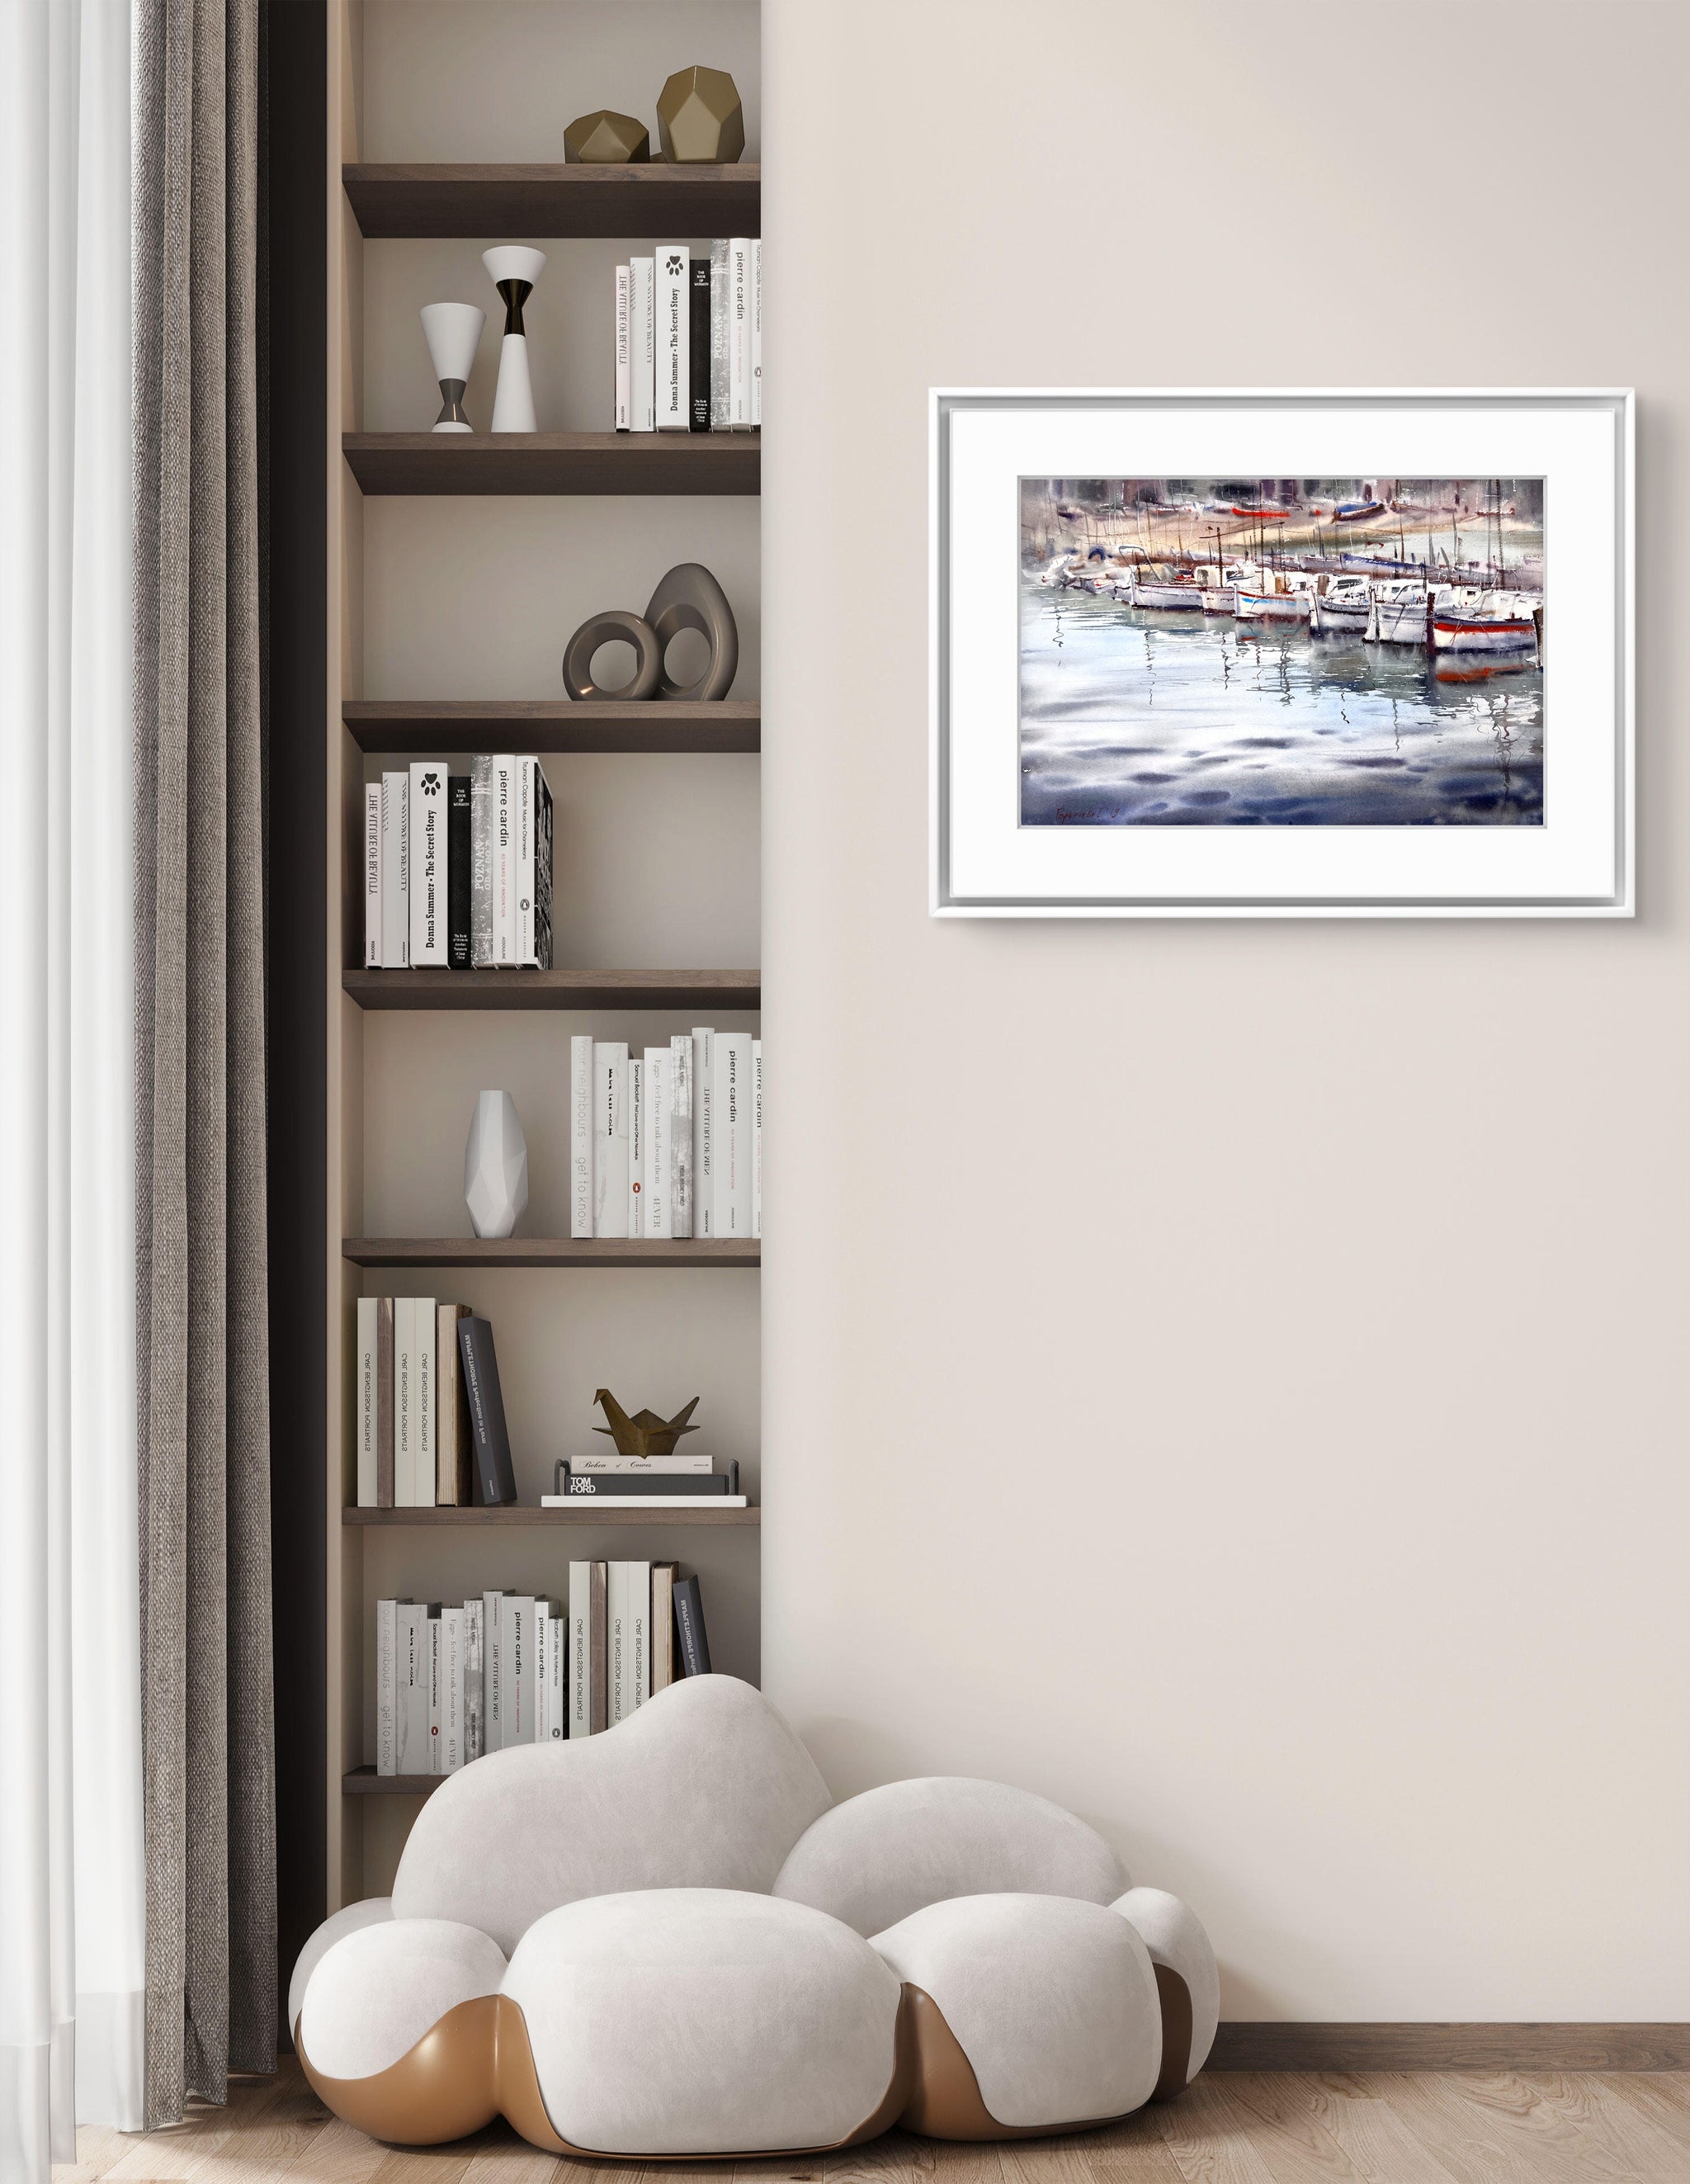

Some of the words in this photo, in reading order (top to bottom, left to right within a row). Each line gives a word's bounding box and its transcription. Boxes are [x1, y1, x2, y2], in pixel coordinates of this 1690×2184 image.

[736, 252, 744, 282] pierre
[670, 288, 680, 307] Story
[737, 286, 745, 319] cardin
[670, 310, 678, 332] Secret
[670, 333, 678, 347] The
[670, 353, 678, 385] Summer
[670, 386, 678, 411] Donna
[498, 771, 508, 805] pierre
[426, 811, 437, 831] Story
[500, 810, 509, 846] cardin
[426, 834, 435, 858] Secret
[426, 860, 435, 876] The
[426, 883, 435, 918] Summer
[426, 920, 435, 948] Donna
[729, 1051, 737, 1083] pierre
[575, 1071, 588, 1137] neighbours
[576, 1157, 588, 1175] get
[578, 1182, 588, 1192] to
[578, 1197, 588, 1228] know
[570, 1477, 591, 1486] TOM
[380, 1630, 393, 1688] neighbours
[381, 1706, 393, 1722] get
[383, 1727, 393, 1737] to
[383, 1741, 393, 1767] know
